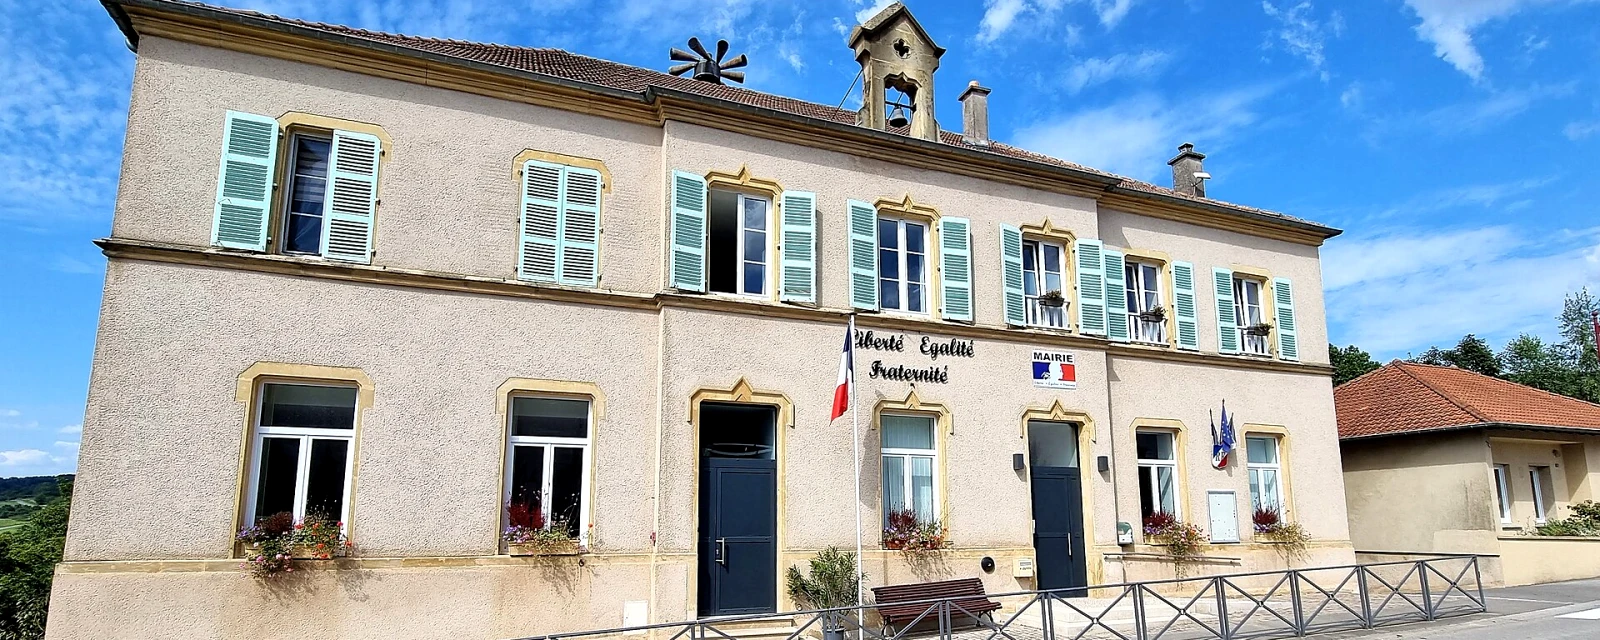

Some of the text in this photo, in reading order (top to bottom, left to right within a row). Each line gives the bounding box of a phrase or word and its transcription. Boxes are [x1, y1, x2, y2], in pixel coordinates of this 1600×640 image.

[920, 336, 975, 360] Egalité
[1033, 352, 1073, 363] MAIRIE
[869, 360, 948, 383] Fraternité
